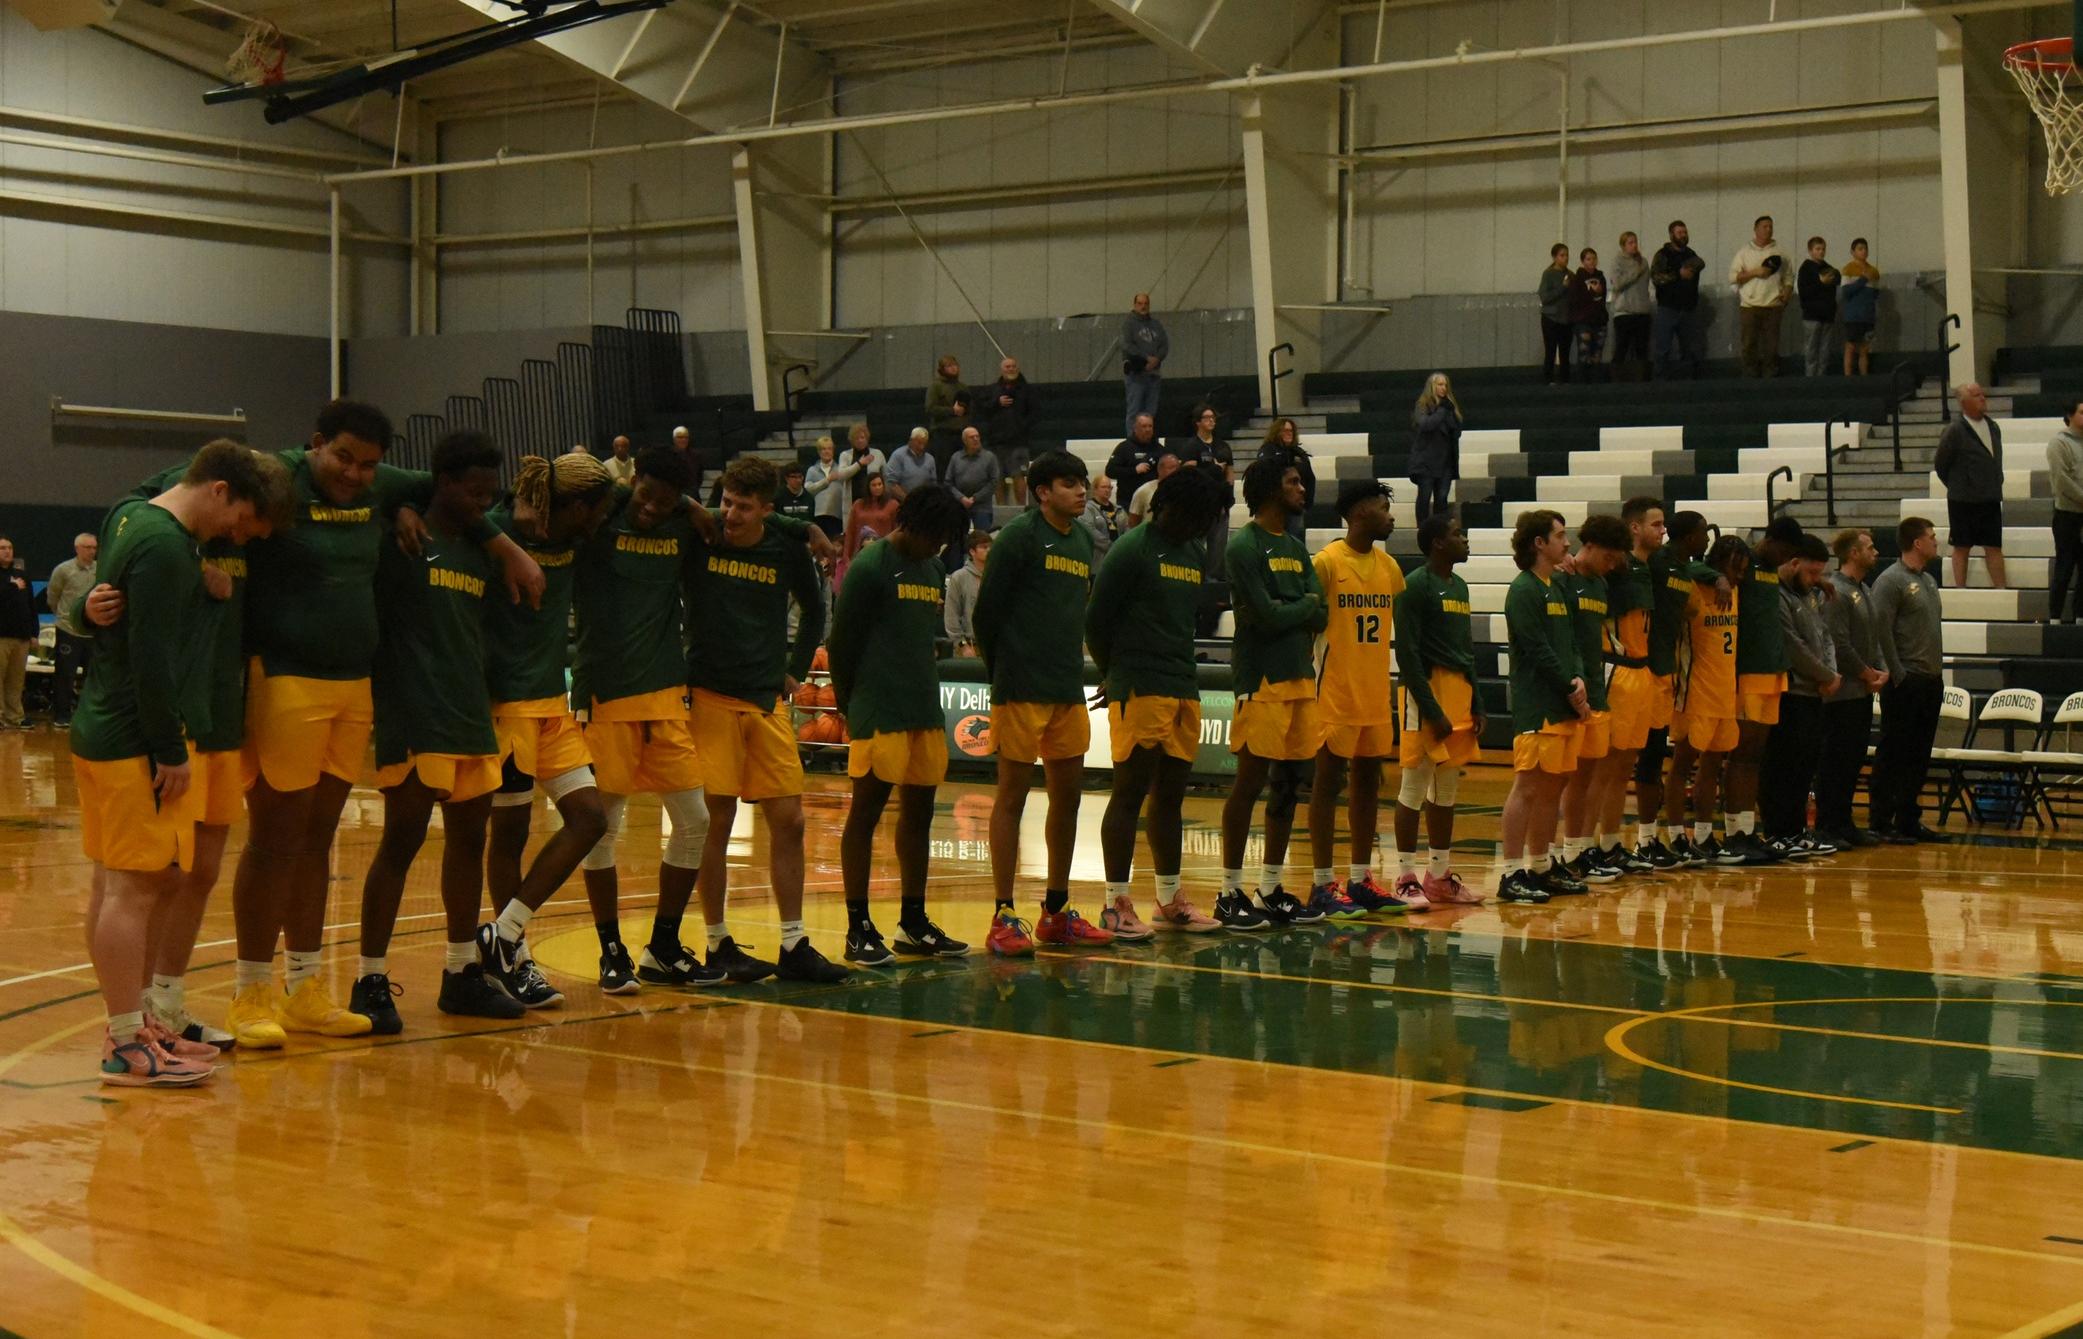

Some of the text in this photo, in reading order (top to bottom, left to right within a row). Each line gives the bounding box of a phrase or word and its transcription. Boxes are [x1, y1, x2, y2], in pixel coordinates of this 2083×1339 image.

[616, 534, 678, 555] BRONCOS
[708, 556, 777, 584] BRONCOS
[429, 567, 486, 598] BRONCOS
[1337, 594, 1391, 608] BRONCOS
[1355, 614, 1380, 643] 12
[1723, 632, 1733, 654] 2
[1991, 694, 2036, 711] BRONCOS
